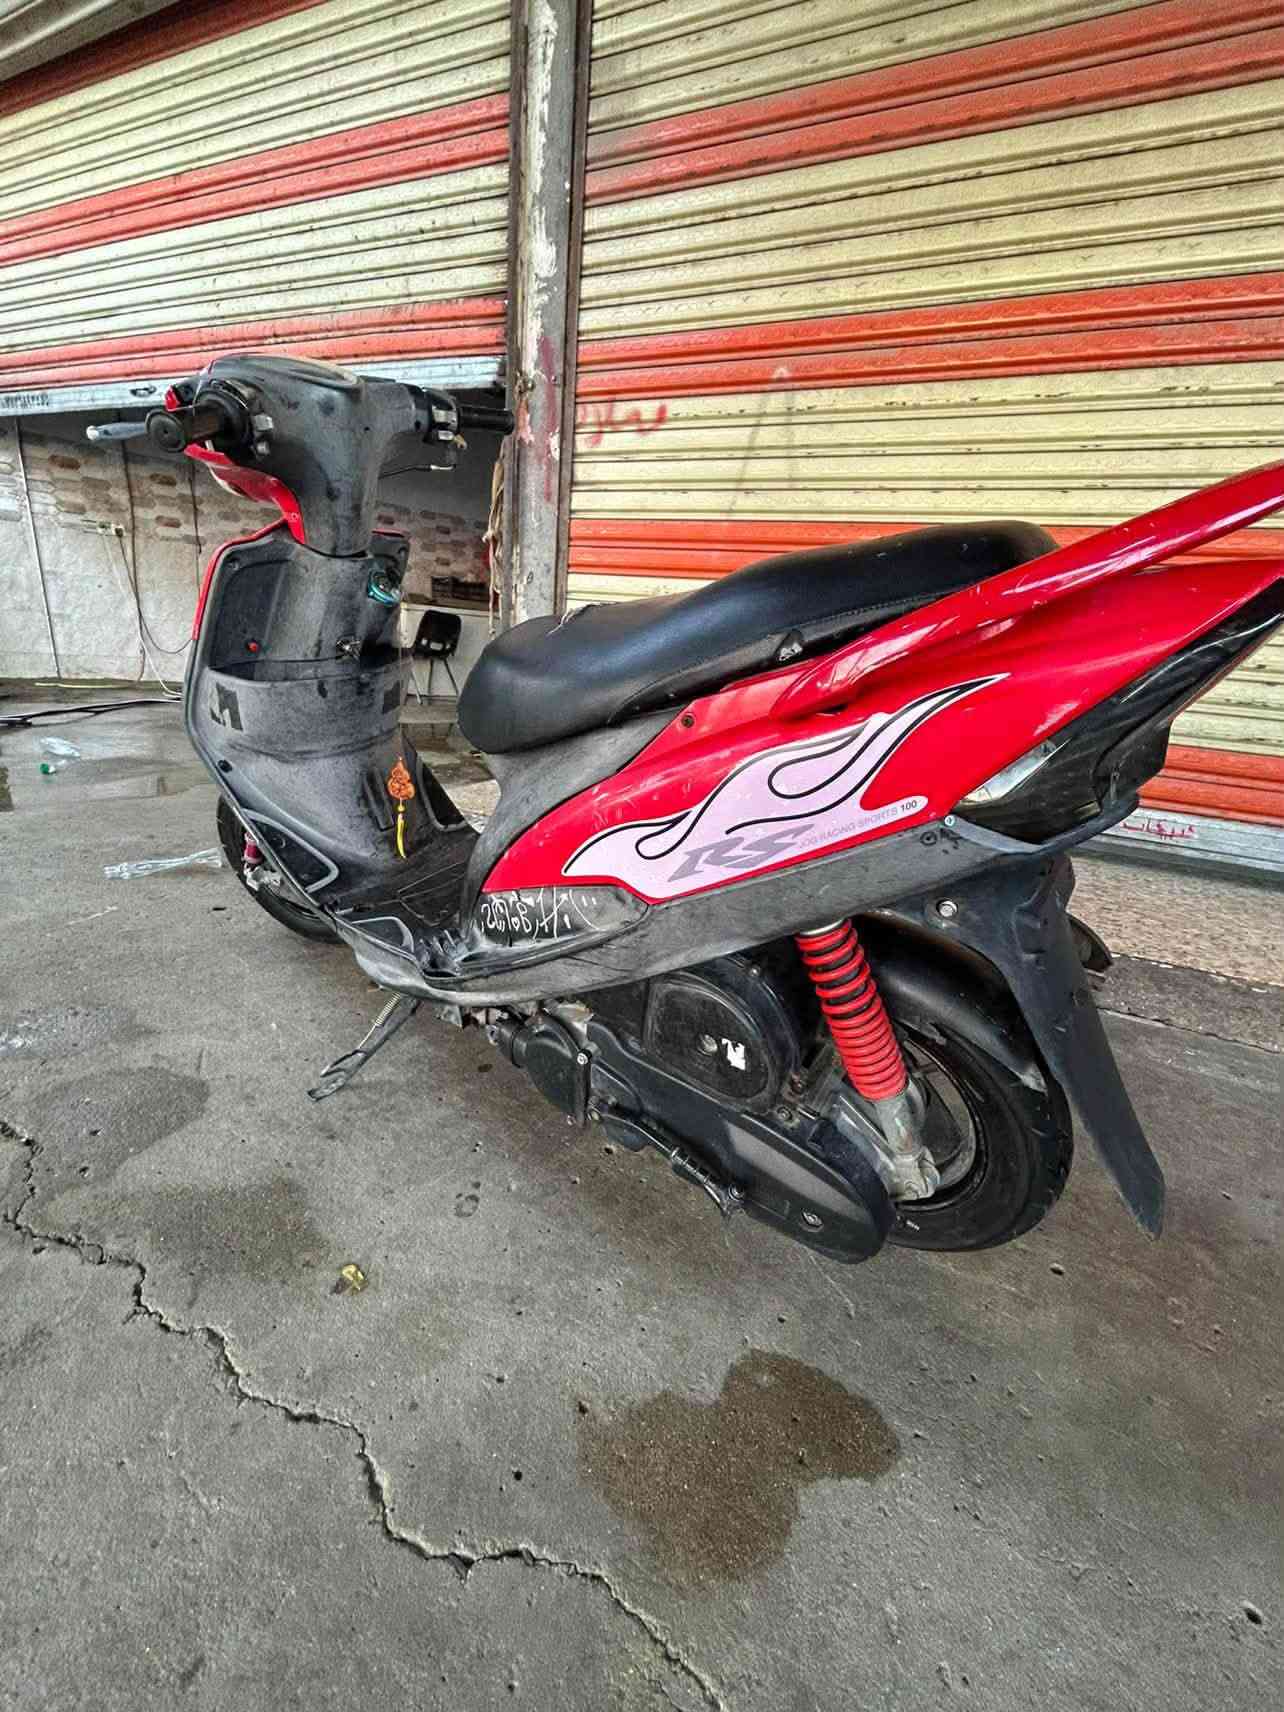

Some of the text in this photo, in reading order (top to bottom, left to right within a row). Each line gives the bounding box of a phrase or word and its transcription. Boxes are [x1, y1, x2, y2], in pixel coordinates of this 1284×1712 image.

[668, 824, 815, 882] RS
[819, 822, 856, 841] RACING
[856, 806, 898, 827] SPORTS
[901, 799, 918, 812] 100
